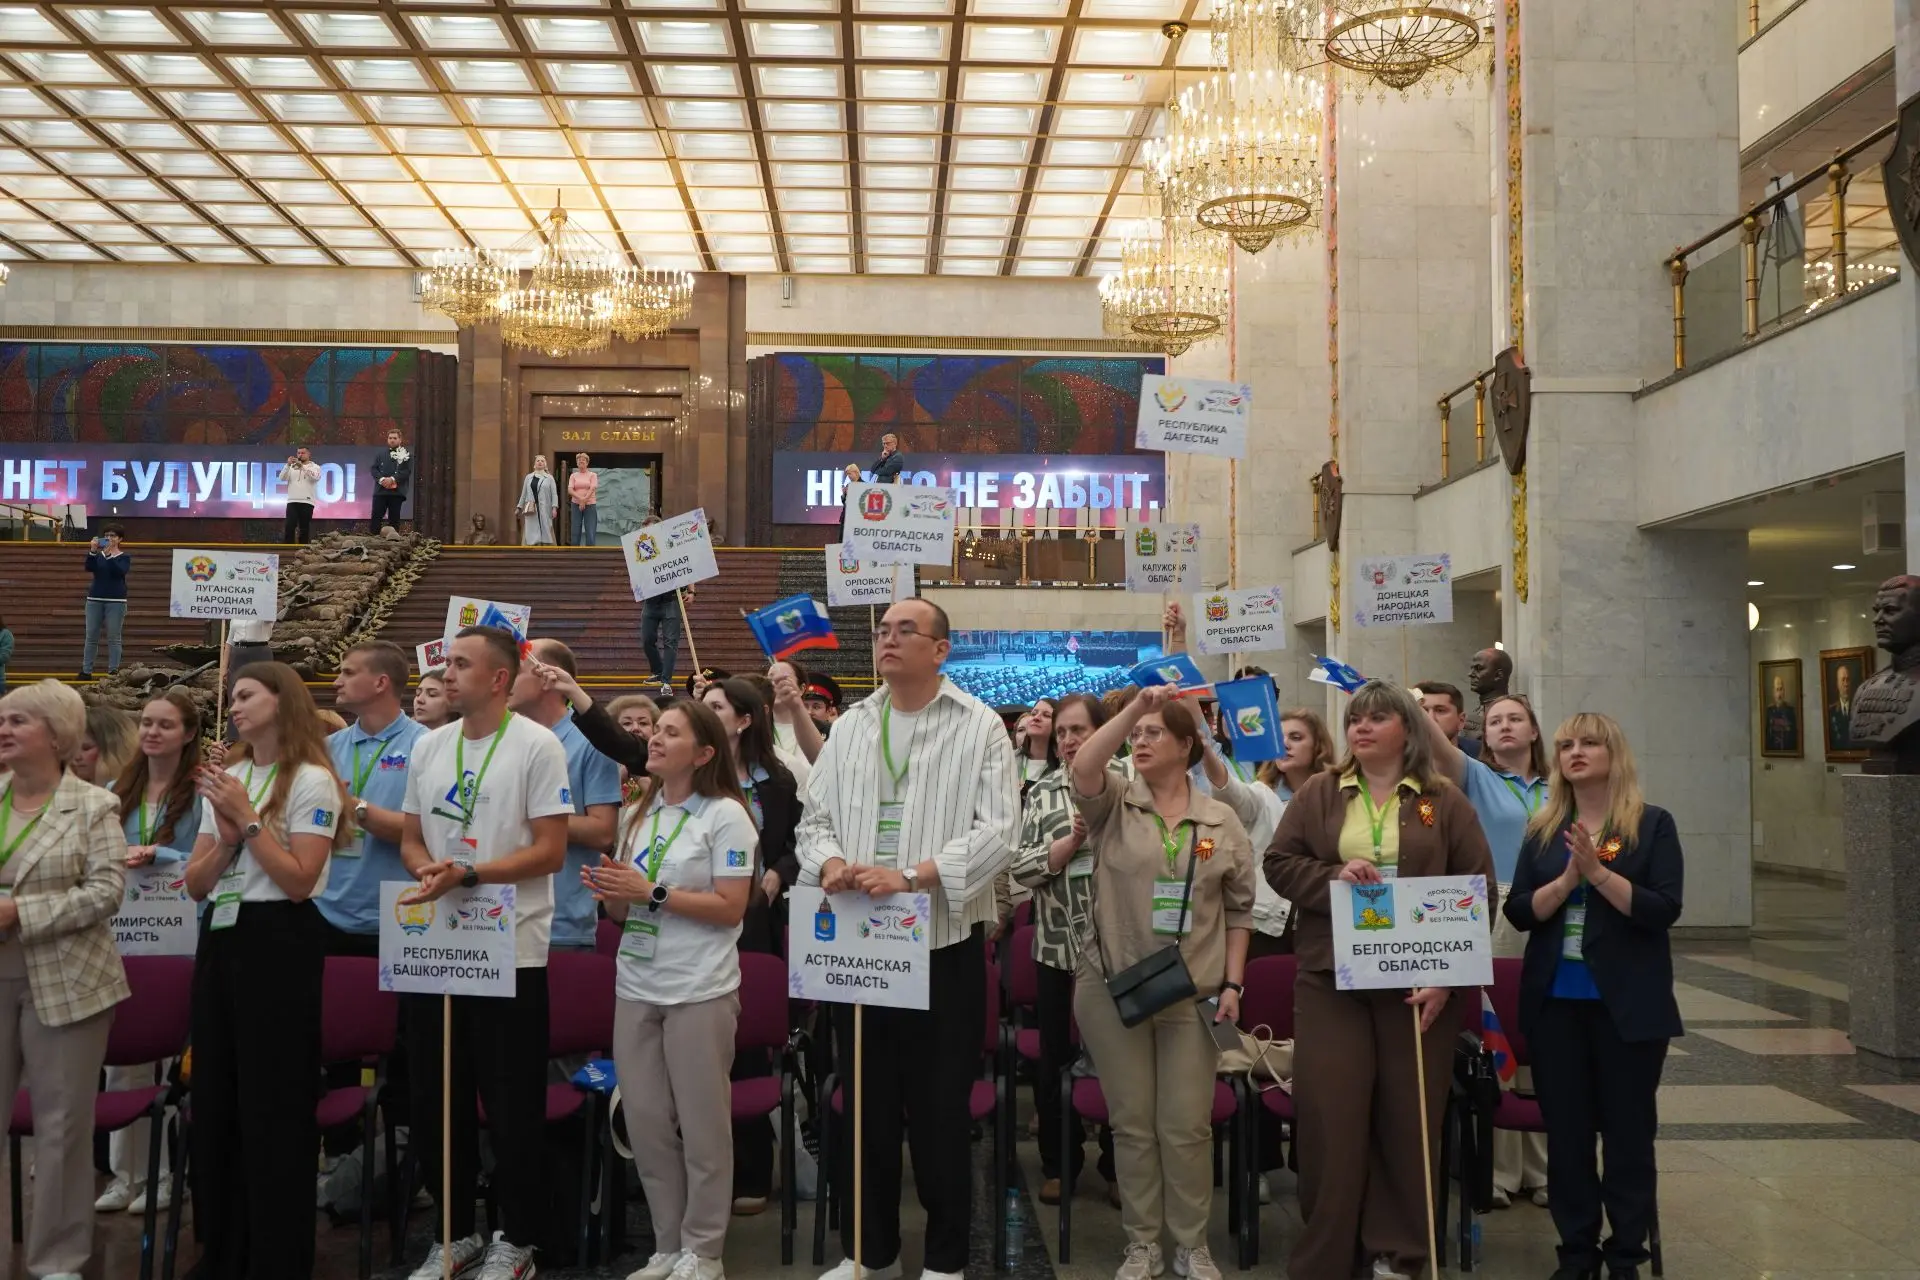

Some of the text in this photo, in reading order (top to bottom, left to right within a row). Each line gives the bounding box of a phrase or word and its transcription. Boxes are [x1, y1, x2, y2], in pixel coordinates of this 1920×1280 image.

[1158, 419, 1227, 434] РЕСПУБЛИКА
[562, 431, 655, 441] ЗАЛ СЛАВЫ
[1164, 432, 1219, 445] ДАГЕСТАН
[2, 459, 356, 509] НЕТ БУДУЩЕО!
[950, 471, 999, 508] НЕ
[1012, 471, 1159, 509] ЗАБЫТ.
[854, 527, 944, 541] ВОЛГОГРАДСКАЯ
[872, 541, 922, 553] ОБЛАСТЬ
[652, 555, 689, 574] КУРСКАЯ
[1142, 563, 1187, 572] КАЛУЖСКЯ
[654, 567, 693, 585] ОБЛАСТЬ
[195, 584, 255, 594] ЛУГАНСКАЯ
[851, 587, 892, 596] ОБЛАСТЬ
[1377, 589, 1429, 601] ДОНЕЦКАЯ
[196, 595, 253, 605] НАРОДНАЯ
[1377, 600, 1430, 611] НАРОДНАЯ
[190, 605, 258, 616] РЕСПУБЛИКА
[1373, 611, 1436, 622] РЕСПУБЛИКА
[1206, 623, 1274, 636] ОРЕНБУРГСКАЯ
[1220, 635, 1261, 645] ОБЛАСТЬ
[1427, 888, 1467, 897] ПРОФСОЮЗ
[110, 916, 183, 928] ИМИРСКАЯ
[116, 931, 159, 942] ЛАСТЬ
[886, 934, 909, 942] ГРАНИЦ
[403, 946, 489, 962] РЕСПУБЛИКА
[1352, 940, 1473, 956] БЕЛГОРОДСКАЯ
[804, 953, 911, 973] АСТРАХАНСКАЯ
[1378, 959, 1450, 972] ОБЛАСТЬ
[393, 963, 500, 980] БАШКОРТОСТАН
[825, 972, 889, 989] ОБЛАСТЬ
